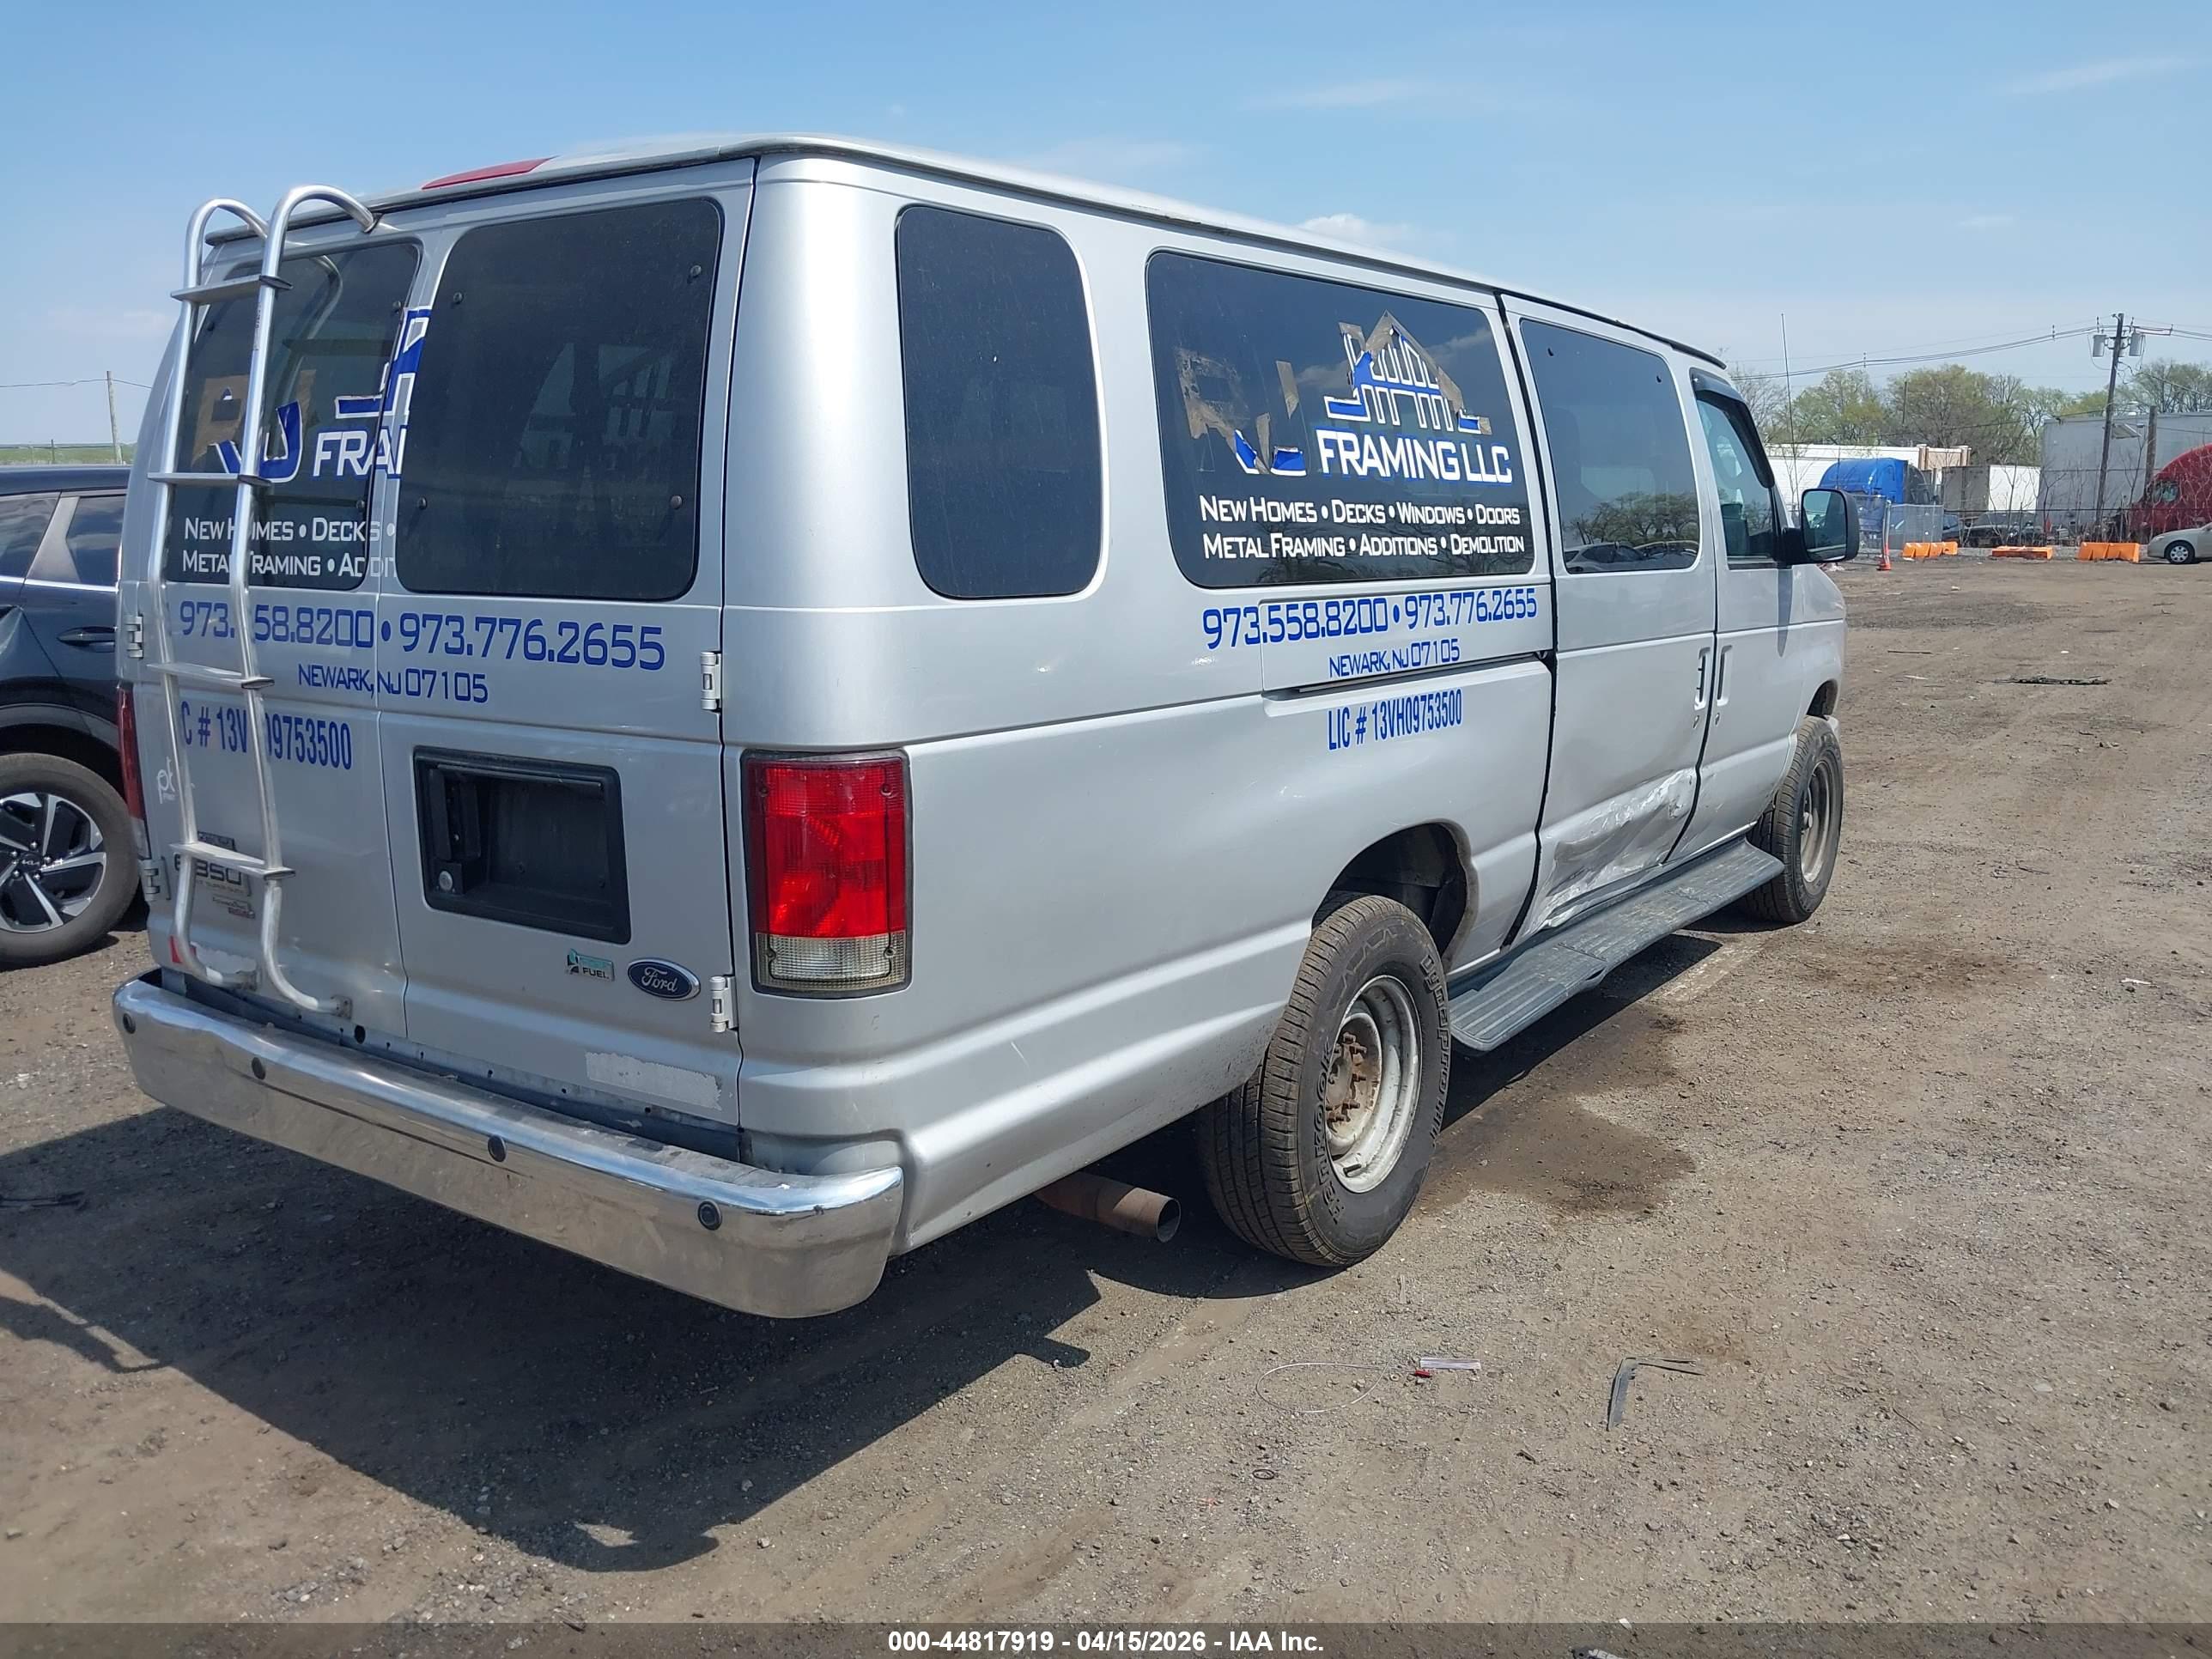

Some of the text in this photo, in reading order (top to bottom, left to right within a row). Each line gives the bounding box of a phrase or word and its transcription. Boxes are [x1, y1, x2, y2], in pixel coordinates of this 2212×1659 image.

[1316, 428, 1512, 483] FRAMING LLC
[180, 601, 665, 671] 973.58.8200 973.776.2655
[1203, 588, 1537, 649] 973.558.8200 973.776.2655
[298, 664, 374, 699] NEWARK,
[405, 668, 488, 703] 07105
[1329, 650, 1390, 678] NEWARK,
[1411, 638, 1460, 666] 07105
[1328, 689, 1462, 750] LIC # 13VH09753500
[641, 967, 678, 994] Ford
